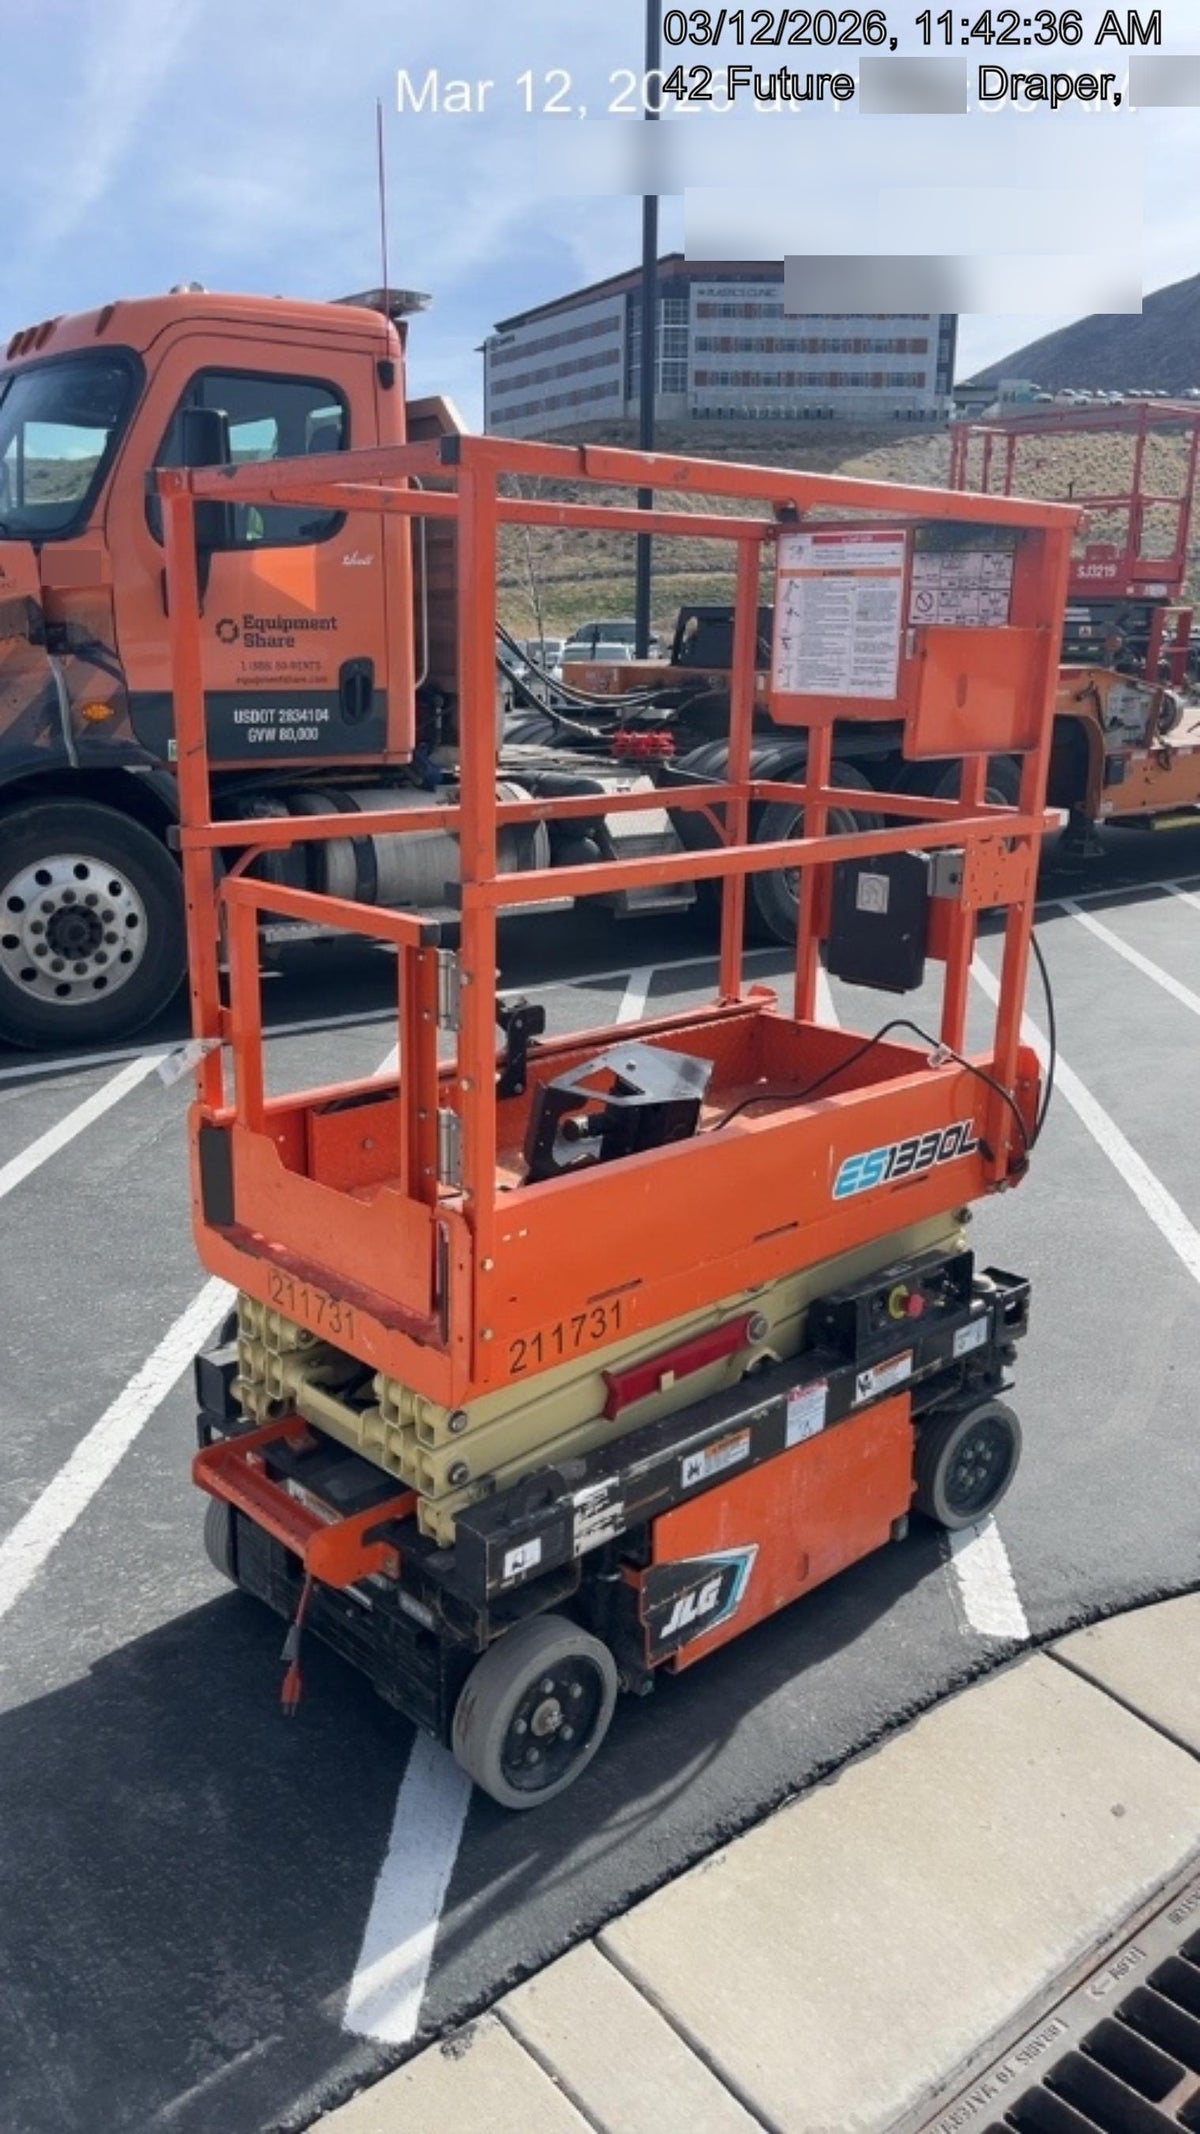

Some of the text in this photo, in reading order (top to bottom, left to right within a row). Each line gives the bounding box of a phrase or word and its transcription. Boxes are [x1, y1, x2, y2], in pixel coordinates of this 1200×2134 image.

[243, 614, 338, 633] Equipment
[244, 633, 295, 648] Share
[234, 708, 330, 724] USDOT 2834104
[248, 727, 319, 743] GVW 80,000
[832, 1118, 979, 1200] ES1330L
[271, 1268, 354, 1341] 211731
[509, 1299, 620, 1374] 211731
[659, 1575, 723, 1639] JLG
